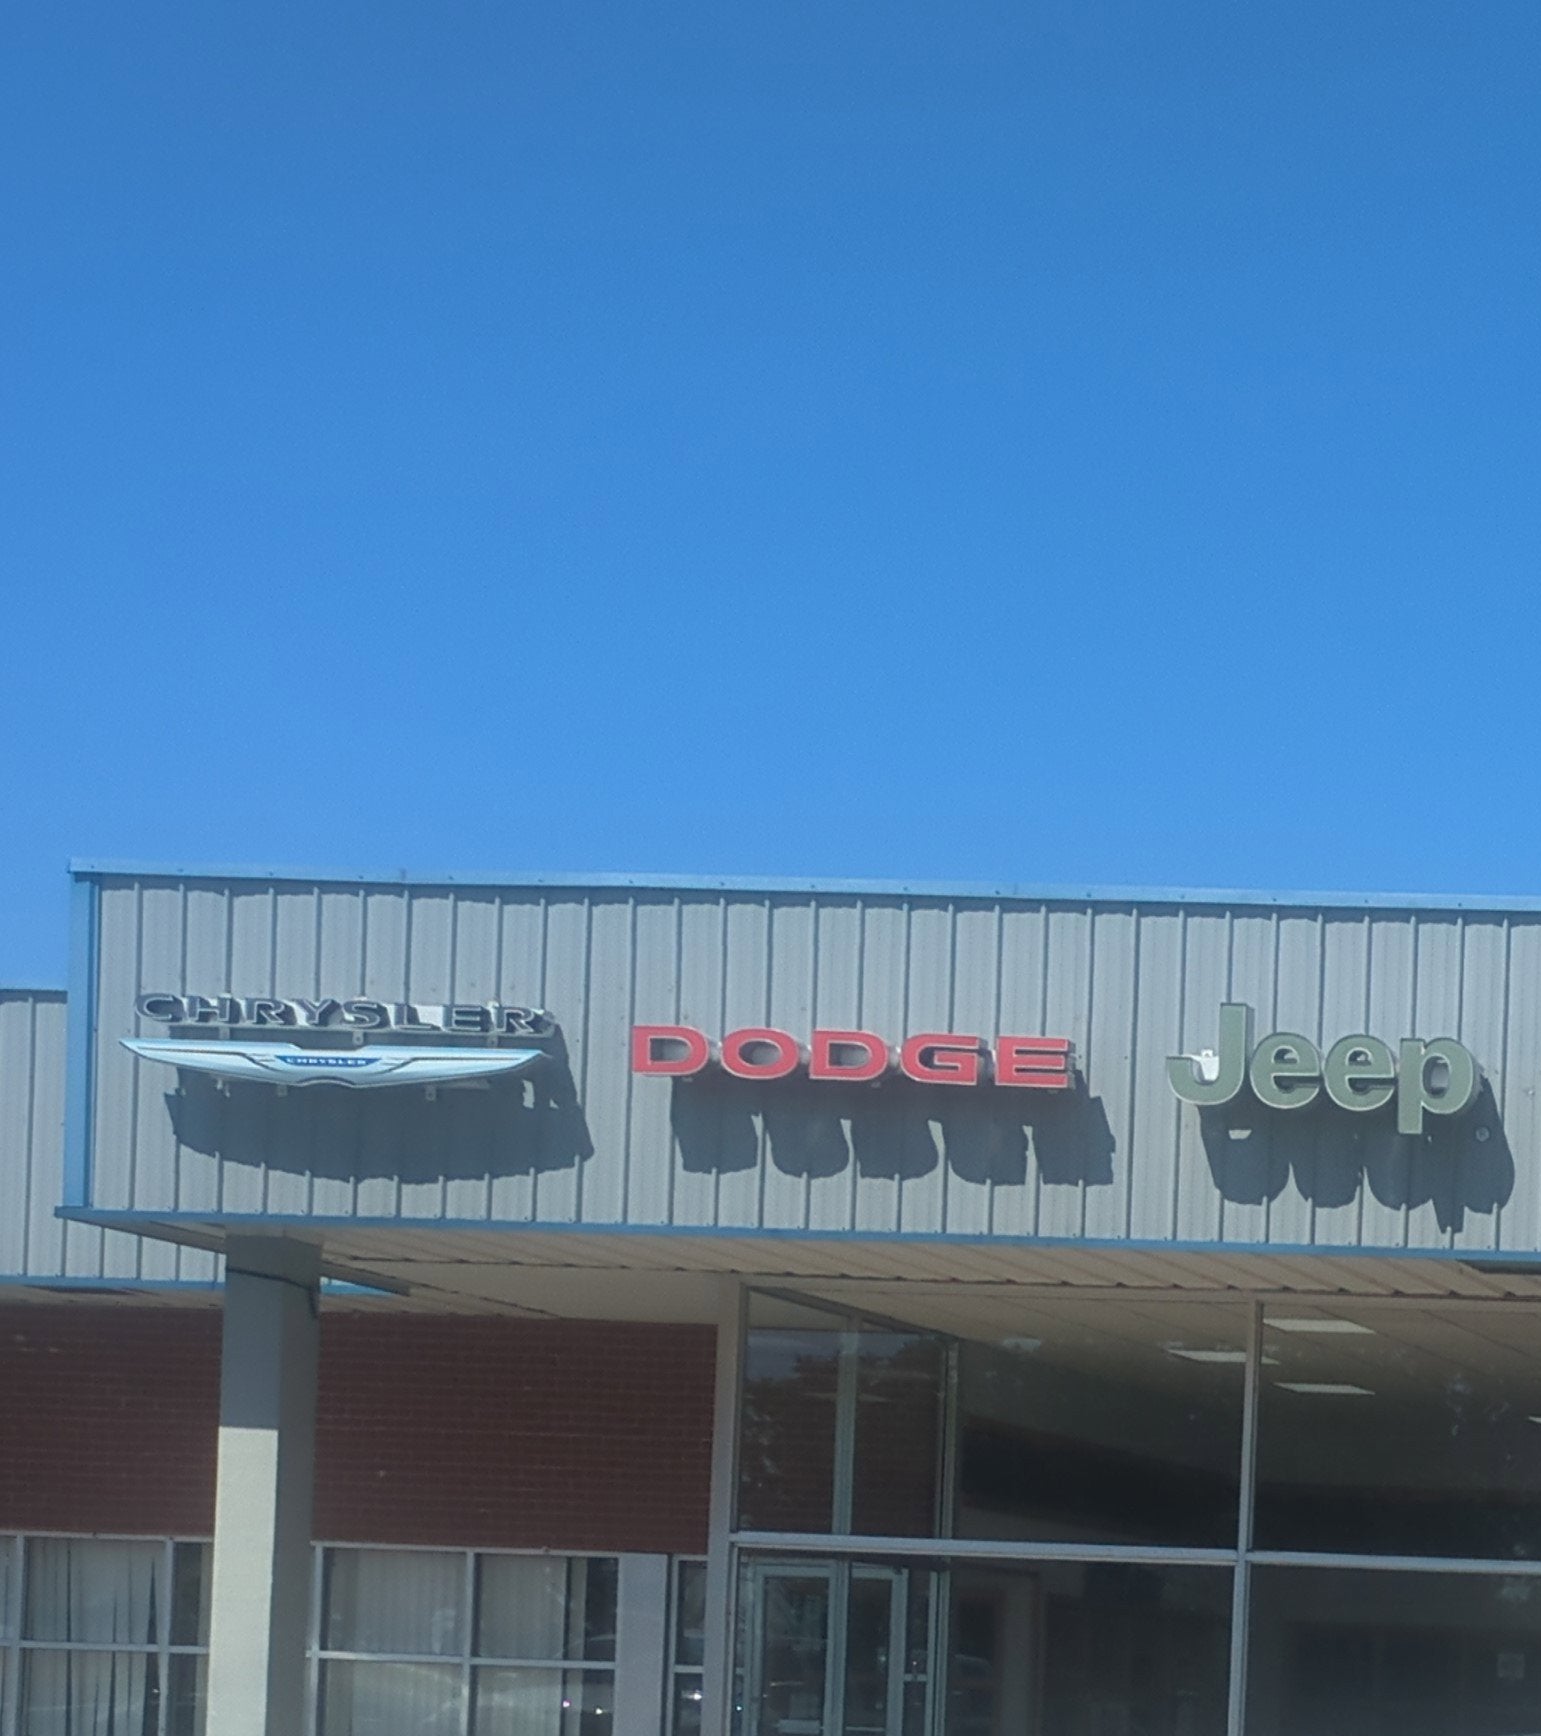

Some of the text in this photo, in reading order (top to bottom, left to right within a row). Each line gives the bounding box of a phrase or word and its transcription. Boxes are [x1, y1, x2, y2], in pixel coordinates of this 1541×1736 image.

[135, 993, 546, 1034] CHRYSLER
[631, 1024, 1073, 1088] DODGE
[1166, 1002, 1478, 1135] Jeep
